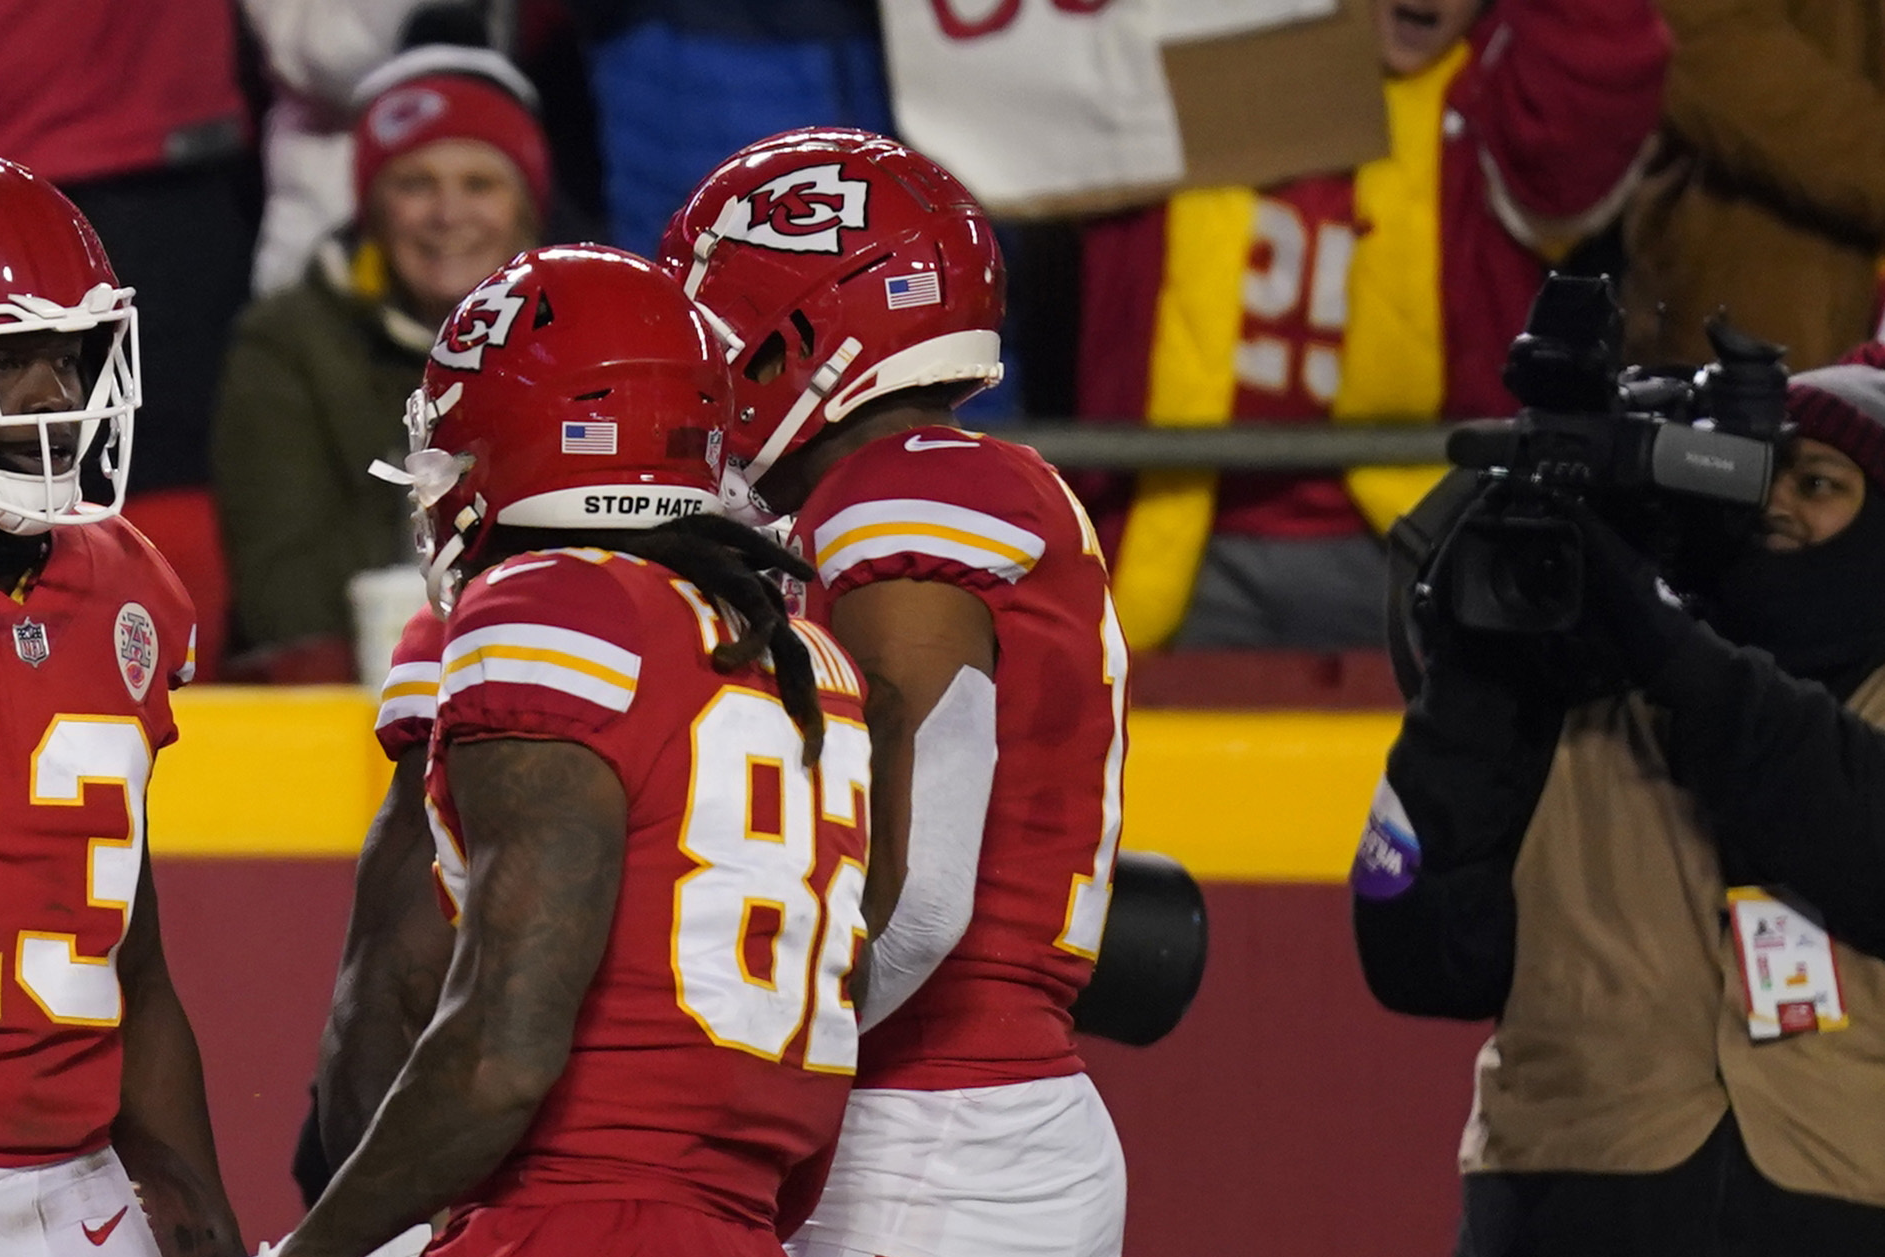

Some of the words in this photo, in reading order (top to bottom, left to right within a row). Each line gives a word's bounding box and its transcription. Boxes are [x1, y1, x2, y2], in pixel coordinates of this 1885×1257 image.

[747, 181, 845, 237] KC
[584, 495, 650, 514] STOP
[655, 497, 703, 517] HATE
[671, 684, 873, 1076] 82
